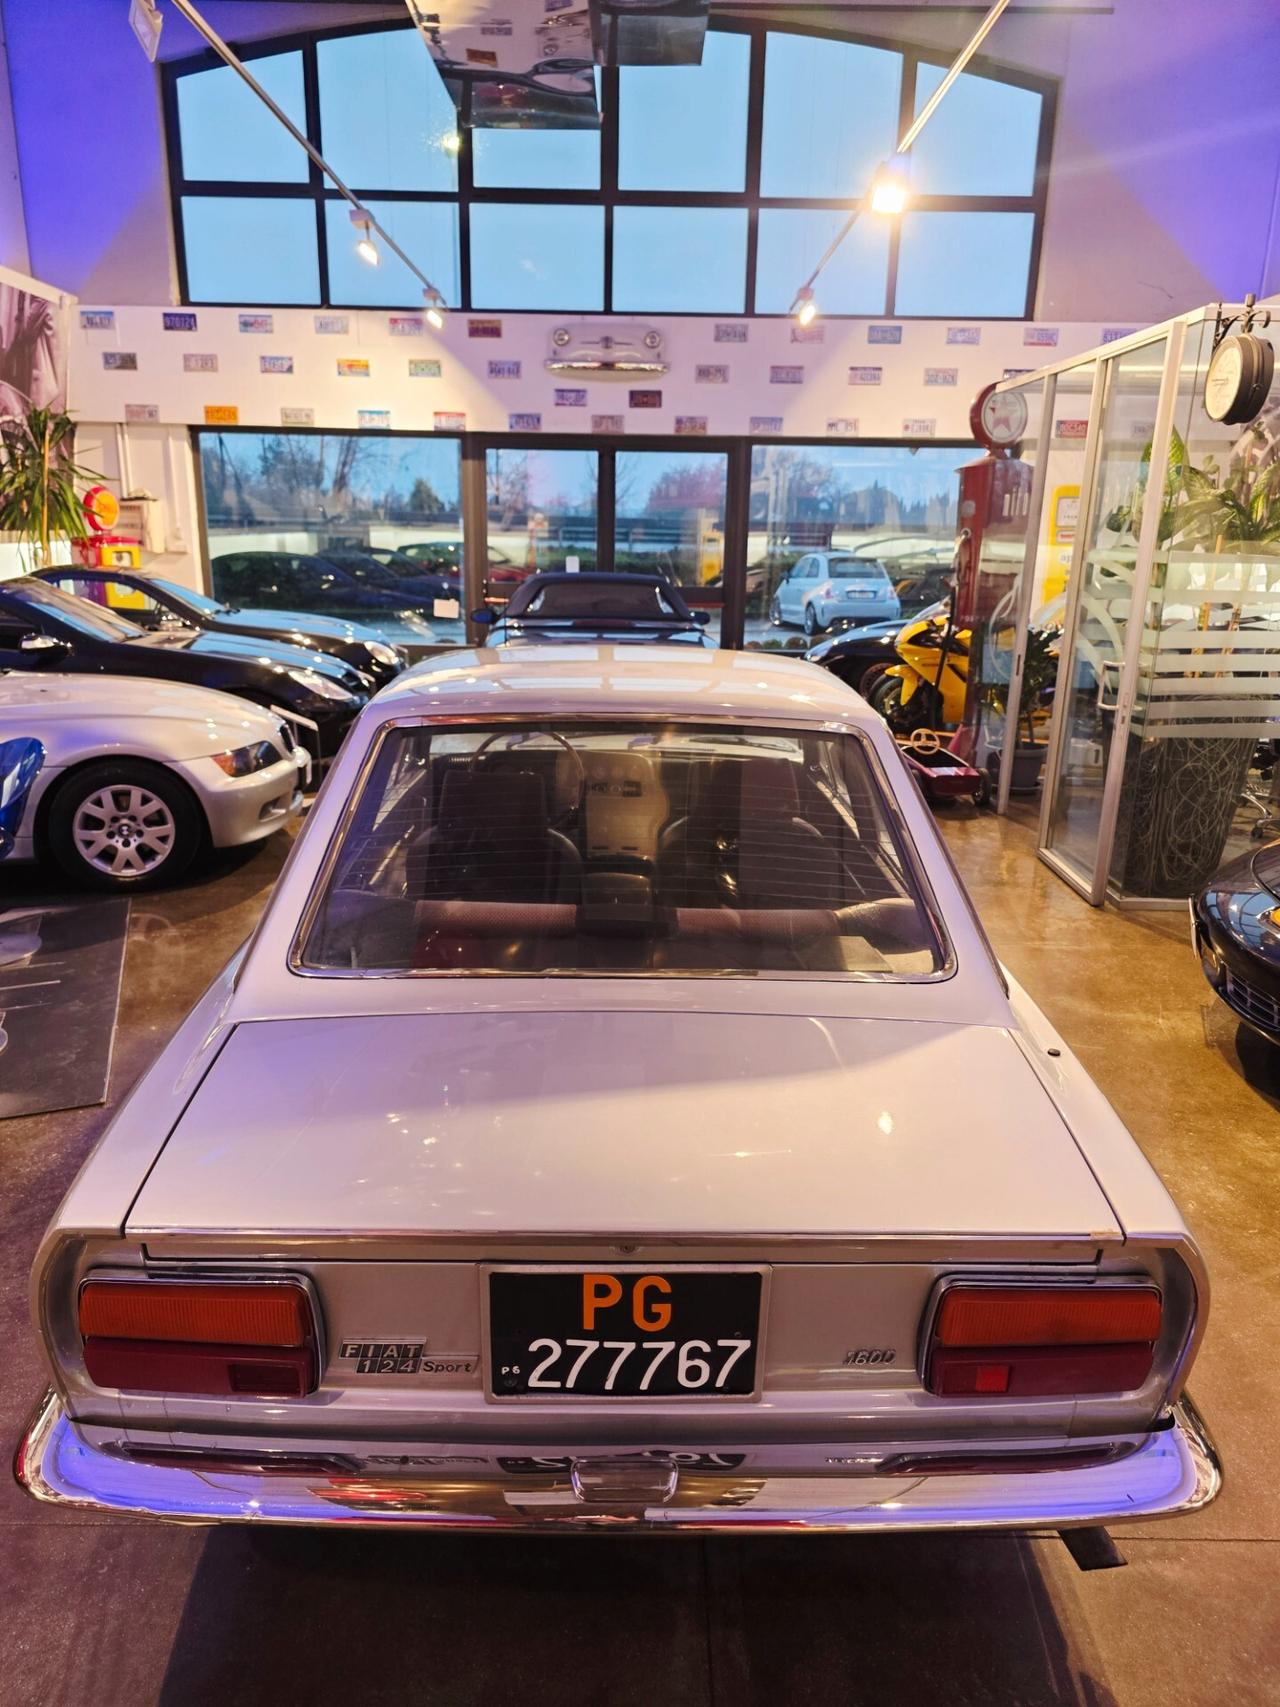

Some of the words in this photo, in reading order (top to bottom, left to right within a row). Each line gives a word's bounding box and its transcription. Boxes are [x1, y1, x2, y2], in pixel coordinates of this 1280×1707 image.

[582, 1274, 672, 1332] PG
[343, 1344, 421, 1358] FIAT
[361, 1359, 416, 1373] 124
[422, 1360, 472, 1374] Sport
[528, 1338, 751, 1391] 277767
